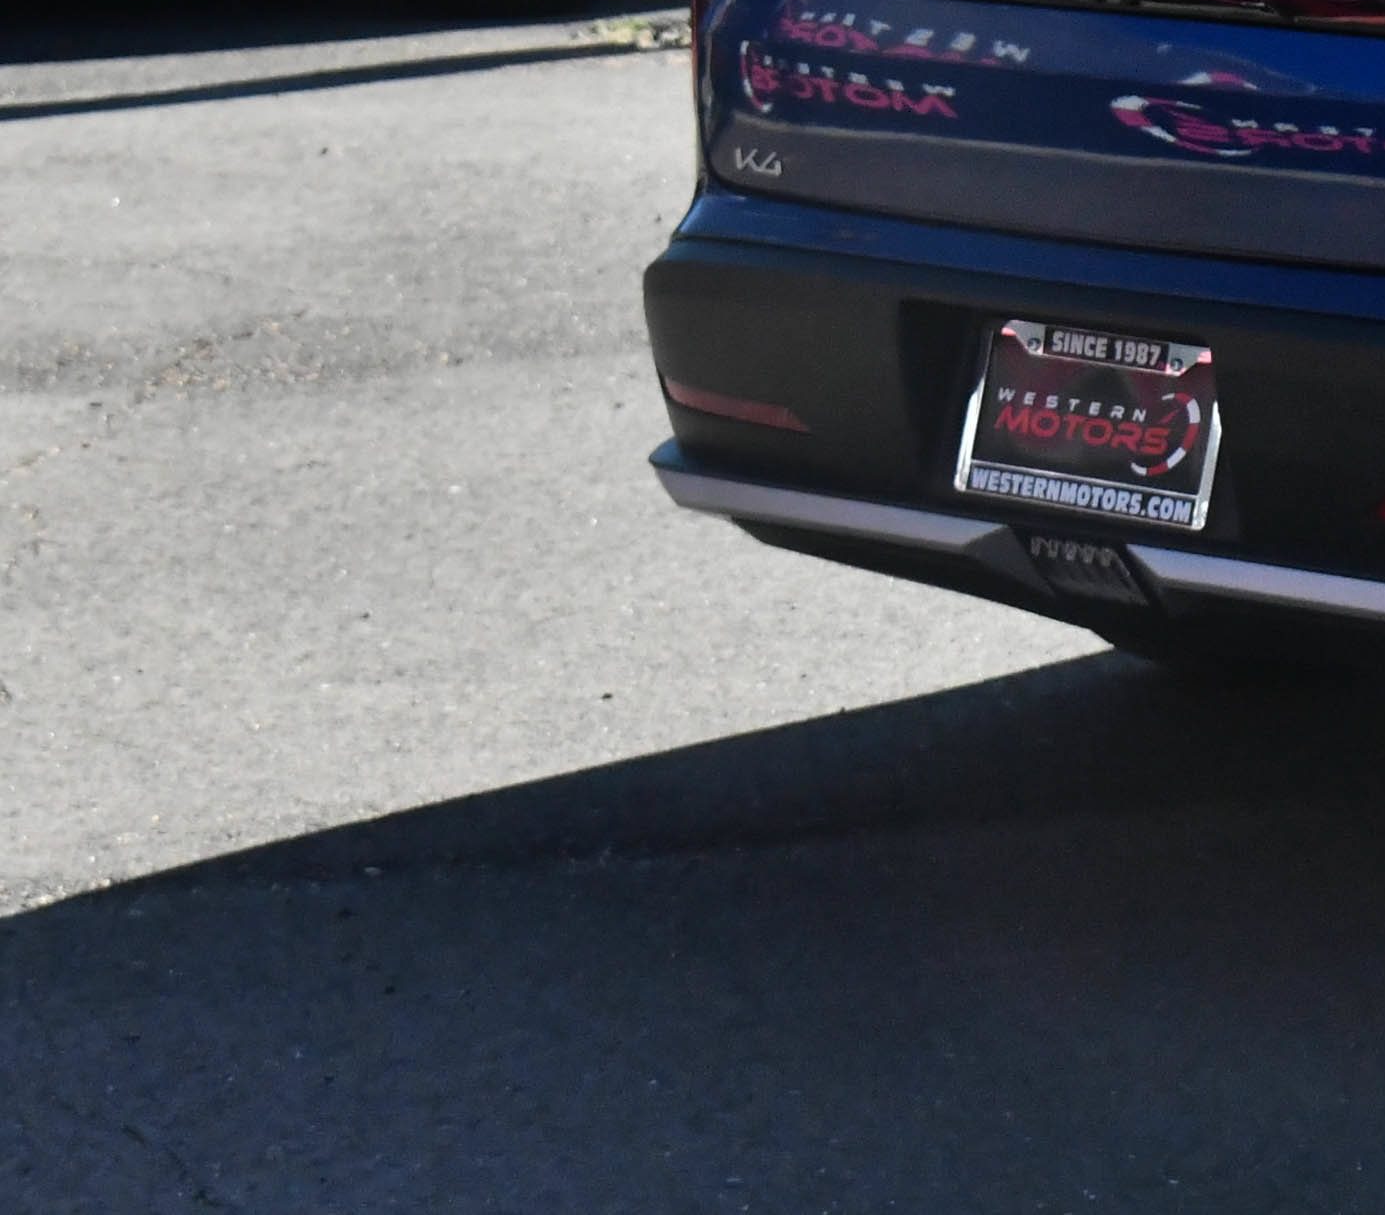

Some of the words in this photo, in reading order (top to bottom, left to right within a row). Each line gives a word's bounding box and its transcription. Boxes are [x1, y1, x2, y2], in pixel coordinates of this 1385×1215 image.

[735, 146, 782, 177] K4
[1052, 331, 1107, 360] SINCE
[1113, 337, 1163, 367] 1987
[997, 386, 1147, 423] WESTERN
[993, 404, 1172, 457] MOTORS
[970, 466, 1194, 525] WESTERNMOTORS.COM
